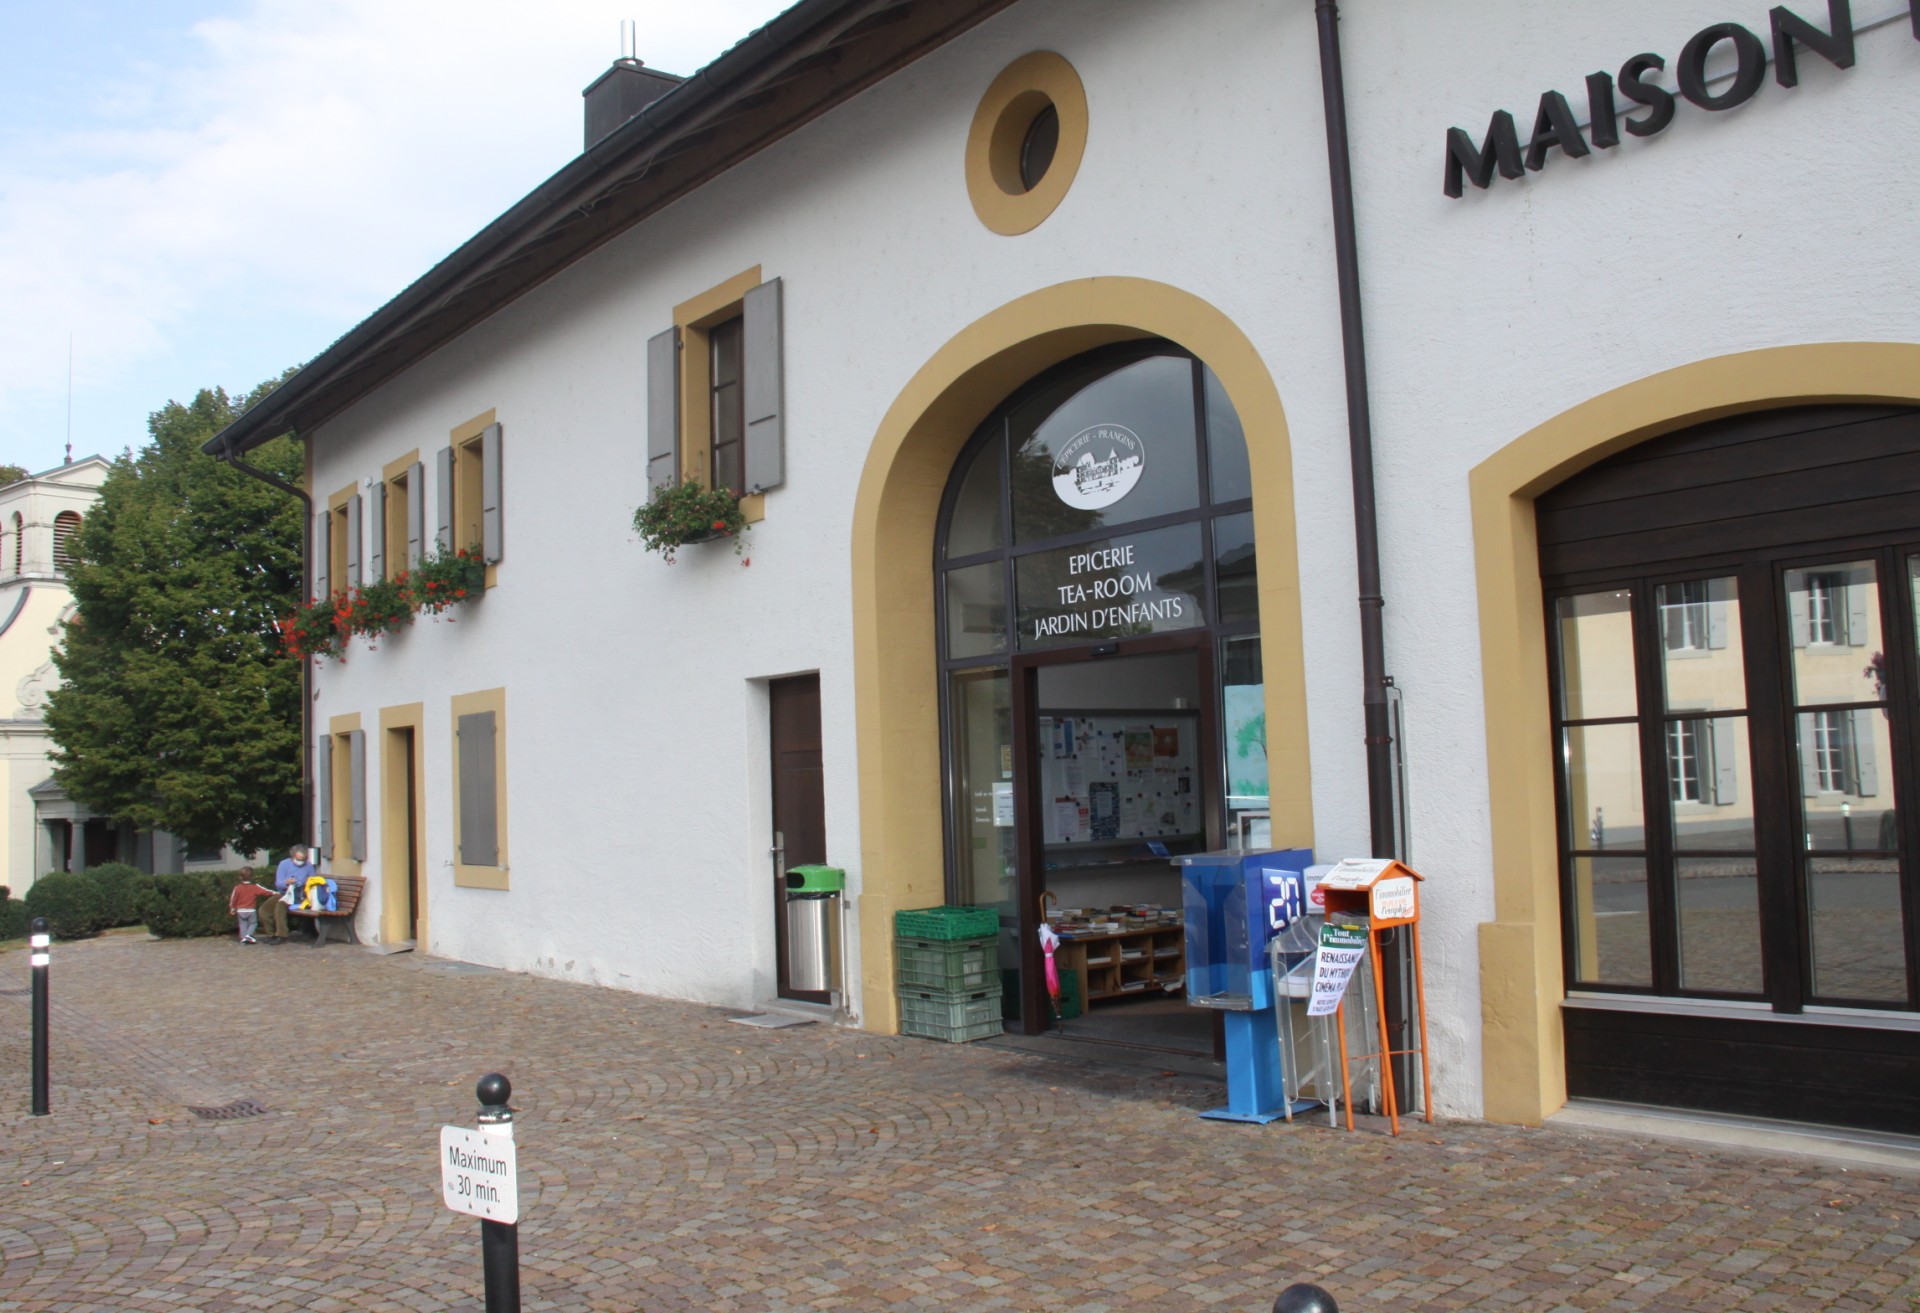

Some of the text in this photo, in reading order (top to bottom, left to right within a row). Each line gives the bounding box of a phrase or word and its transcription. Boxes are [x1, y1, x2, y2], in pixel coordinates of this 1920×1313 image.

[1444, 0, 1855, 200] MAISON
[1098, 429, 1136, 450] PRANGINS
[1069, 545, 1135, 575] EPICERIE
[1057, 572, 1152, 605] TEA-ROOM
[1034, 597, 1182, 640] JARDIN D'ENFANTS
[1269, 876, 1301, 930] 20
[1333, 928, 1350, 937] Tout
[1319, 966, 1330, 978] DU
[449, 1145, 507, 1177] Maximum
[457, 1174, 501, 1204] 30 min.
